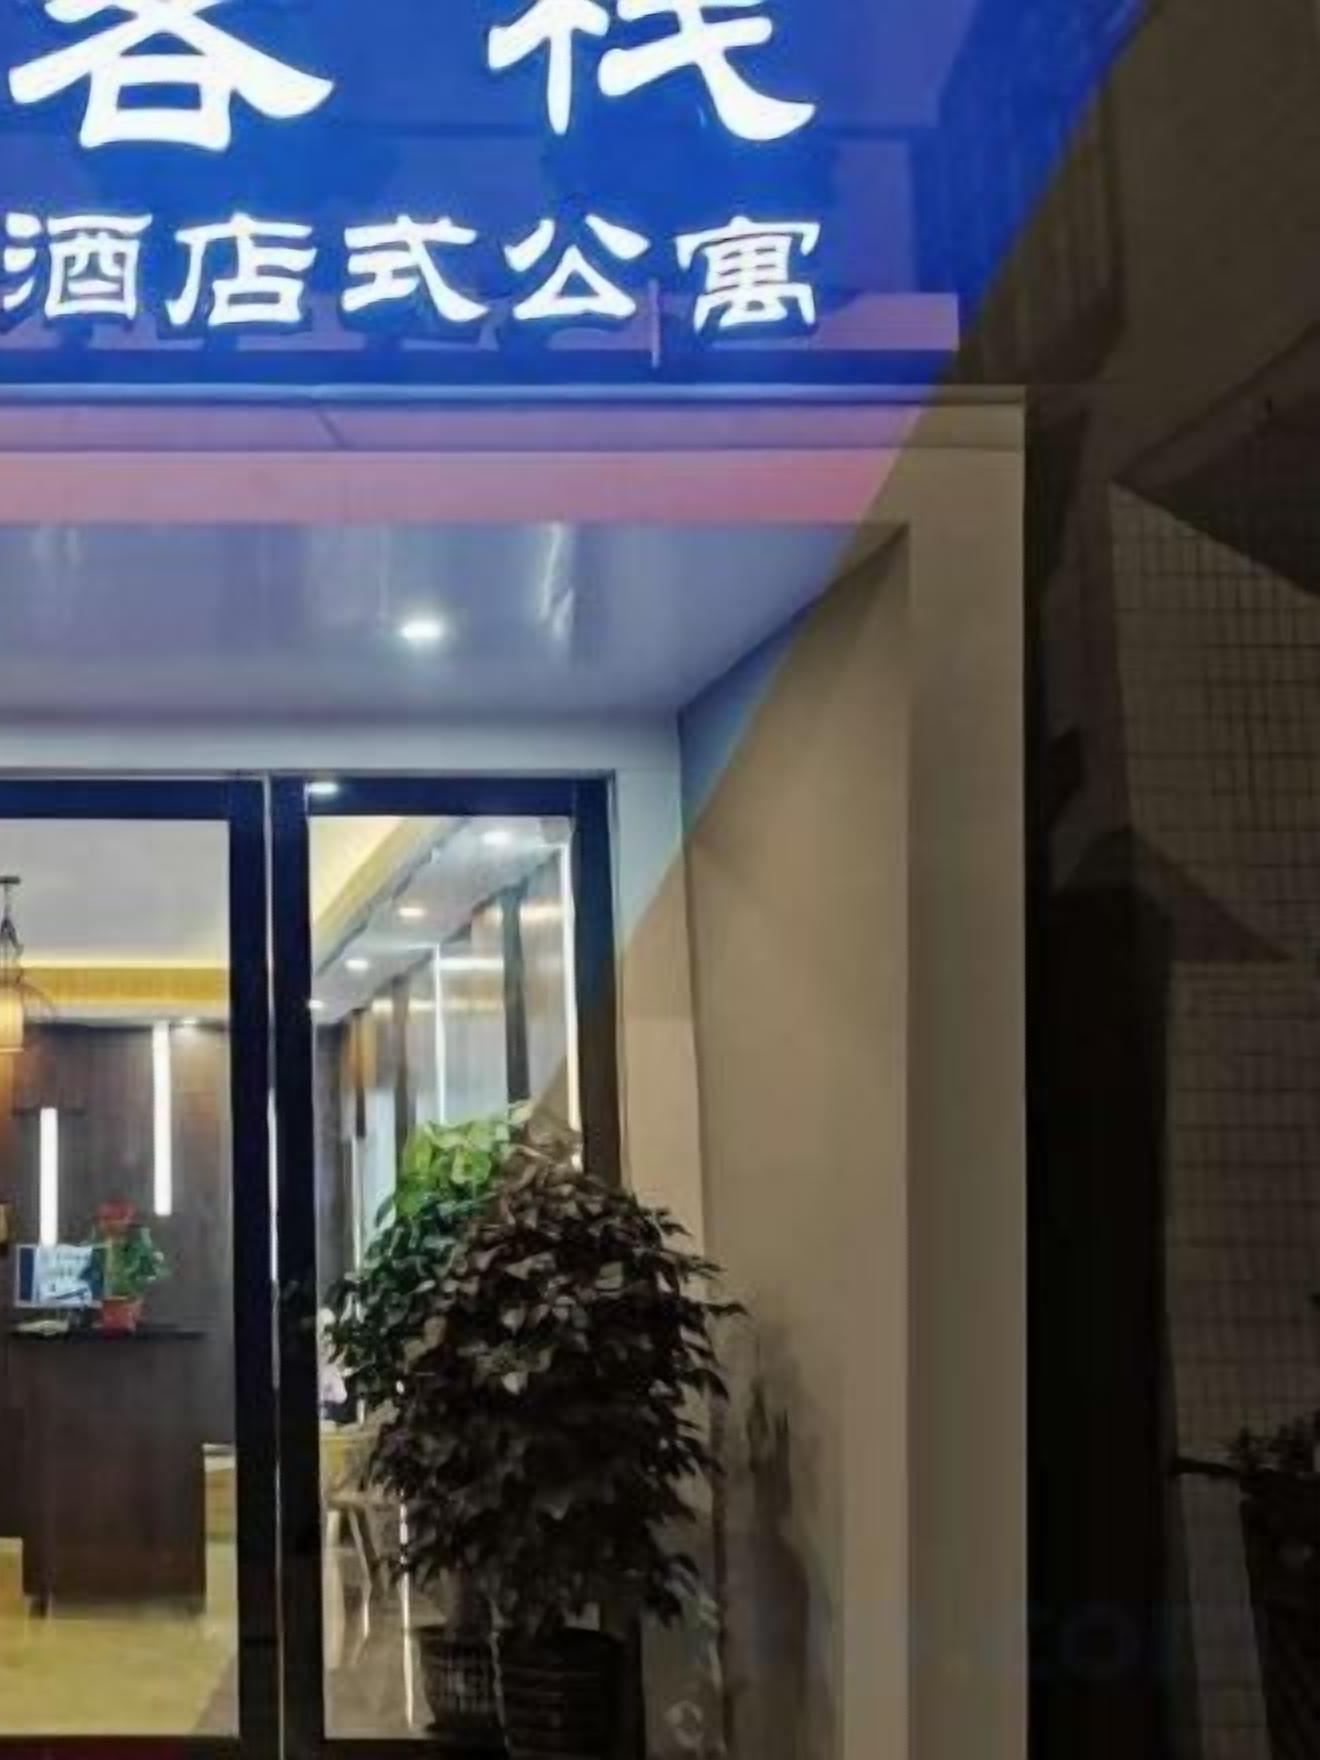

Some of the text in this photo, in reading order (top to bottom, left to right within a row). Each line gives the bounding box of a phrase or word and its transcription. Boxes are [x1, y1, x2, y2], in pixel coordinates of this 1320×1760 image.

[2, 212, 820, 326] 酒店式公寓
